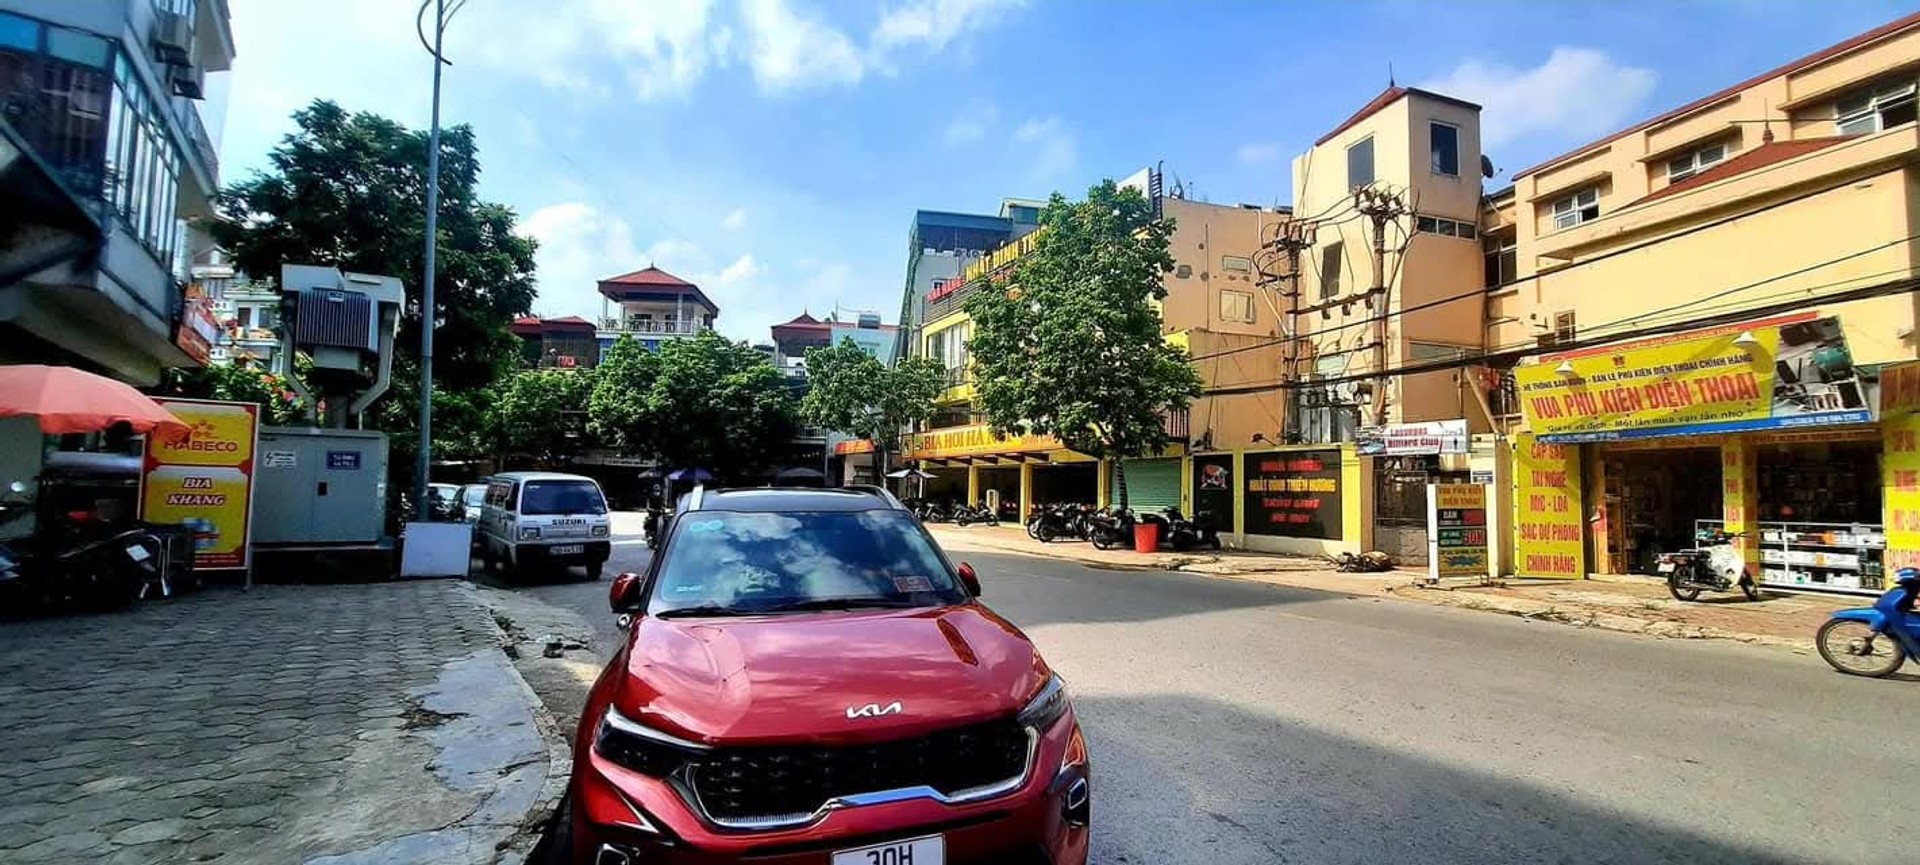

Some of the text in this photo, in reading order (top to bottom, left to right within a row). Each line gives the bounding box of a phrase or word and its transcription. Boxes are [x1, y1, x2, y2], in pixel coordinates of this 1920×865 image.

[1531, 371, 1761, 420] VUA PHỤ KIỆN ĐIỆN THOẠI
[924, 435, 942, 450] BIA
[184, 477, 213, 488] BIA
[167, 495, 226, 505] KHANG
[1530, 494, 1546, 512] MIC
[1521, 520, 1580, 544] SẠC DỰ PHÒNG
[1526, 551, 1551, 572] CHÍNH
[846, 701, 903, 718] KIA
